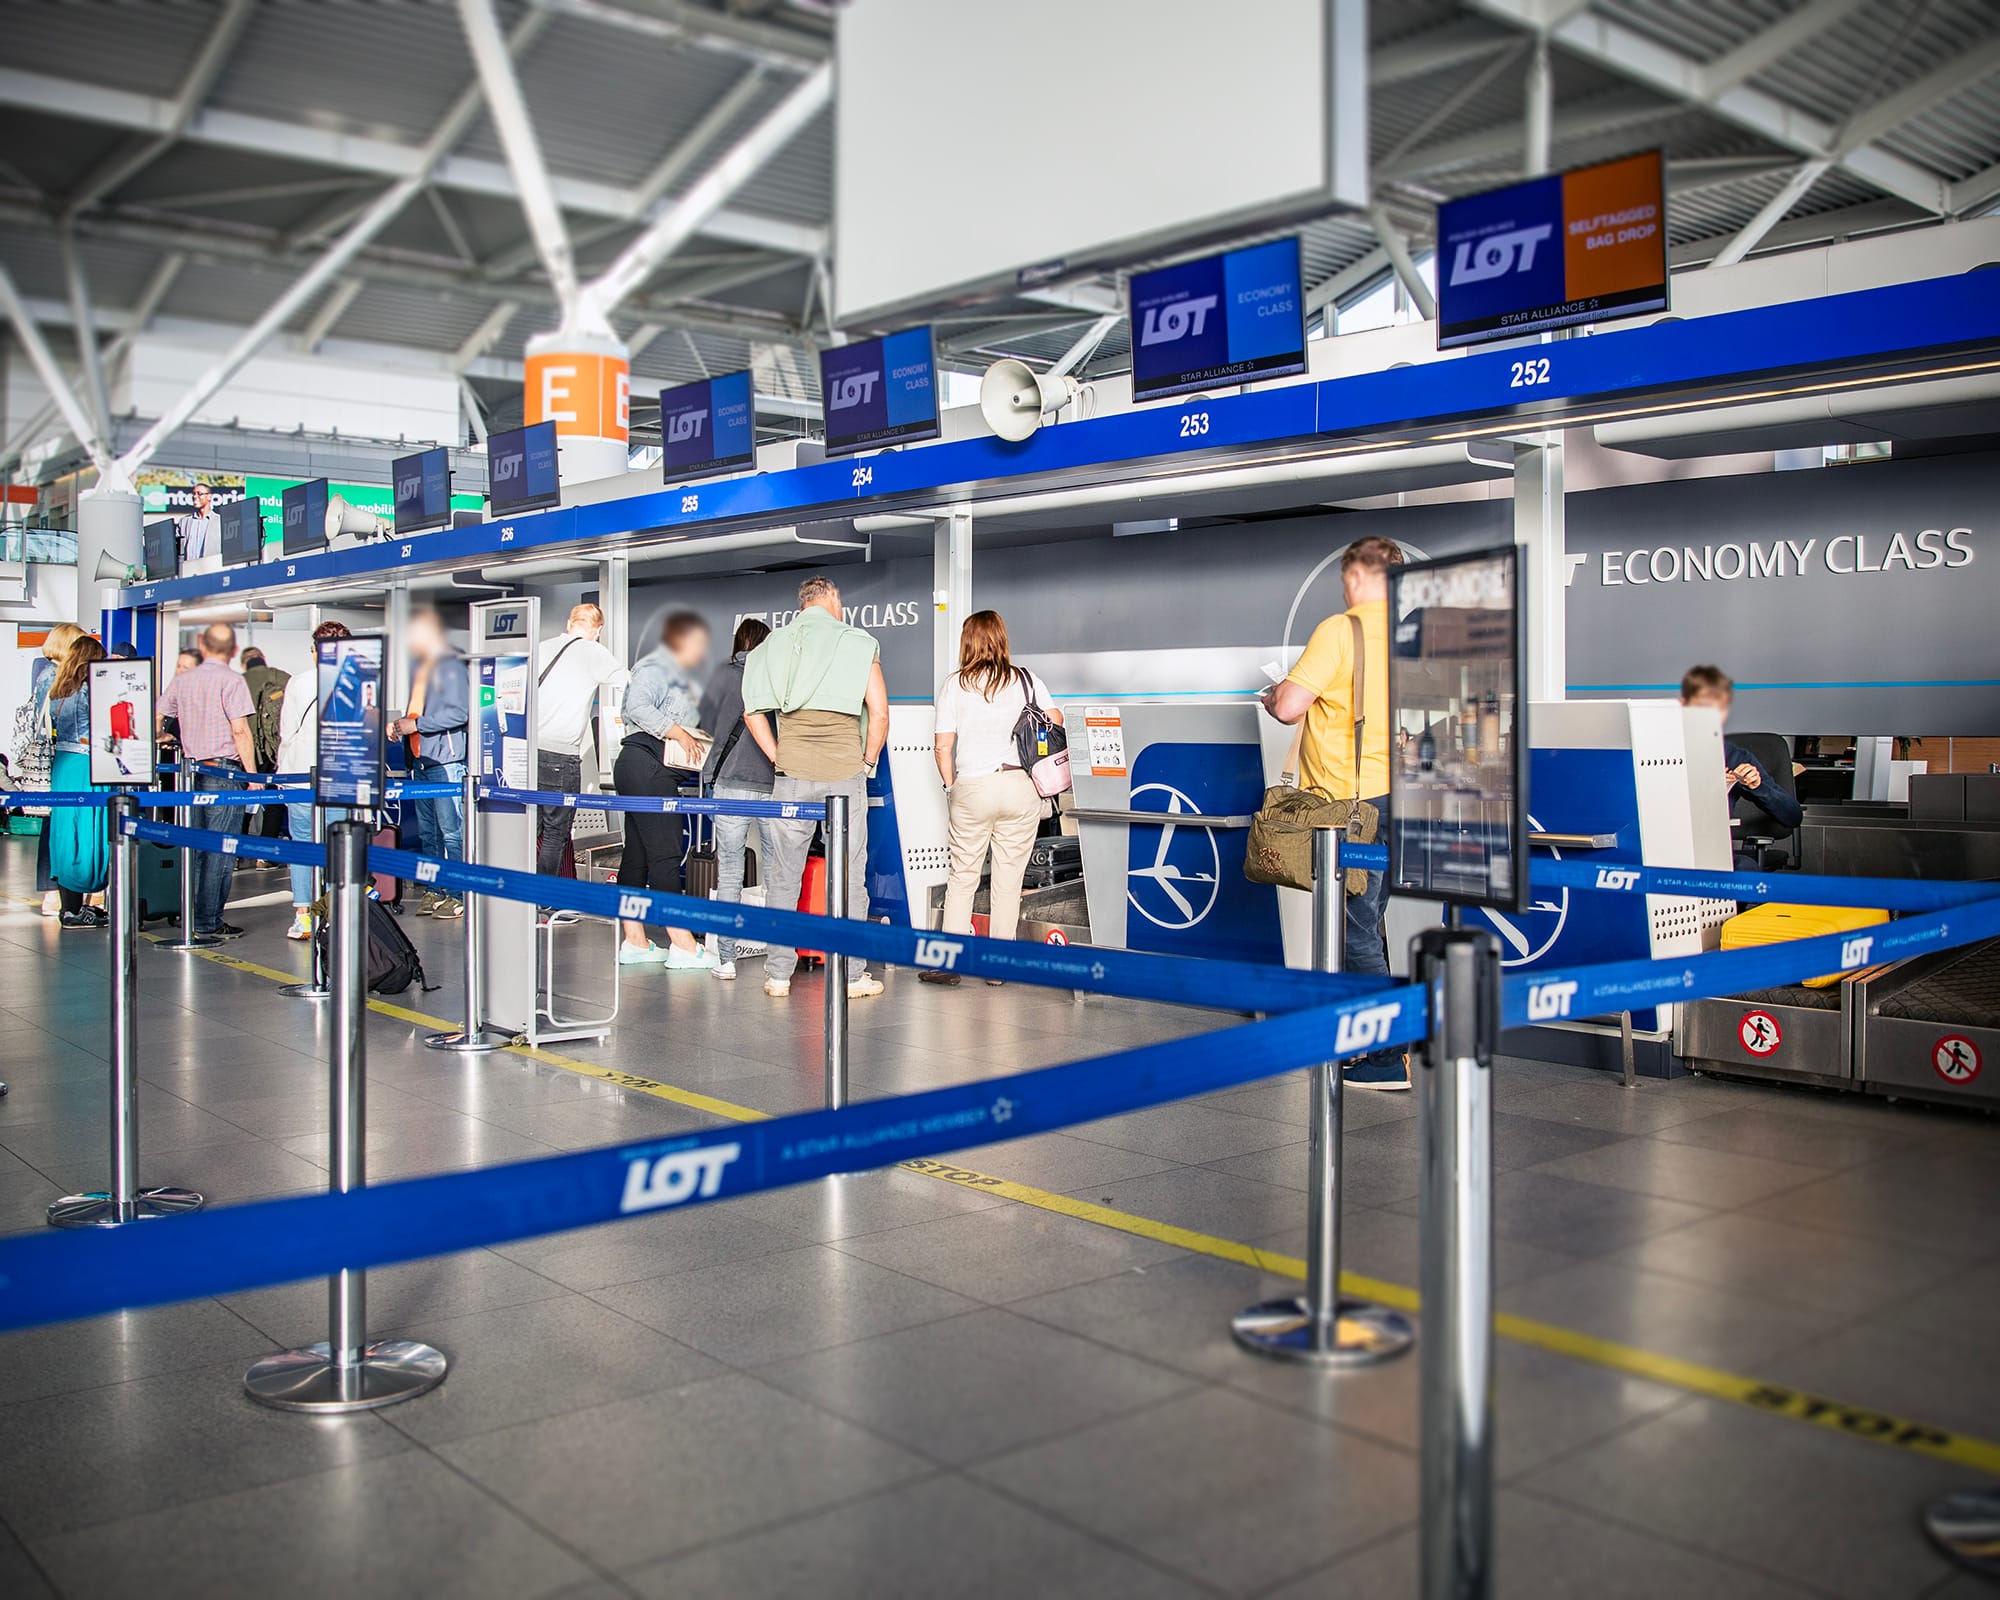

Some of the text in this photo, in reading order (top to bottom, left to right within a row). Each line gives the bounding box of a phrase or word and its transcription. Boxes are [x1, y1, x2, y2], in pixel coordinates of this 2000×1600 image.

[1568, 205, 1656, 235] SELFTAGGED
[1586, 224, 1656, 250] BAG DROP
[1450, 223, 1553, 287] LOT
[1237, 284, 1291, 304] ECONOMY
[1141, 294, 1218, 347] LOT
[1257, 301, 1294, 317] CLASS
[1501, 301, 1586, 326] STAR ALLIANCE
[892, 363, 928, 379] ECONOMY
[1180, 364, 1245, 383] STAR ALLIANCE
[1511, 359, 1550, 388] 252
[542, 367, 576, 422] E
[830, 370, 880, 411] LOT
[905, 378, 929, 390] CLASS
[718, 403, 747, 416] ECONOMY
[727, 416, 748, 427] CLASS
[668, 409, 708, 443] LOT
[857, 427, 899, 442] STAR ALLIANCE
[1180, 413, 1209, 437] 253
[493, 453, 523, 482] LOT
[852, 466, 872, 486] 254
[397, 476, 421, 501] LOT
[286, 504, 305, 528] LOT
[682, 495, 698, 513] 255
[501, 527, 513, 541] 256
[401, 545, 412, 558] 257
[1601, 538, 1816, 587] ECONOMY
[1824, 527, 1975, 575] CLASS
[493, 614, 518, 632] LOT
[861, 601, 920, 628] CLASS
[120, 672, 136, 681] Fast
[127, 683, 147, 692] Track
[192, 794, 219, 805] LOT
[385, 789, 403, 799] OT
[663, 800, 678, 812] LOT
[781, 805, 799, 818] LOT
[1595, 870, 1641, 891] LOT
[1663, 878, 1681, 886] STAR
[1683, 880, 1718, 889] ALLIANCE
[1720, 882, 1753, 891] MEMBER
[618, 895, 652, 920] LOT
[914, 938, 964, 970] LOT
[1841, 936, 1874, 969] LOT
[1527, 981, 1577, 1021] LOT
[1334, 1002, 1401, 1055] LOT
[620, 1142, 741, 1212] LOT
[901, 1160, 1003, 1185] STOP
[1745, 1384, 1951, 1445] STOP
